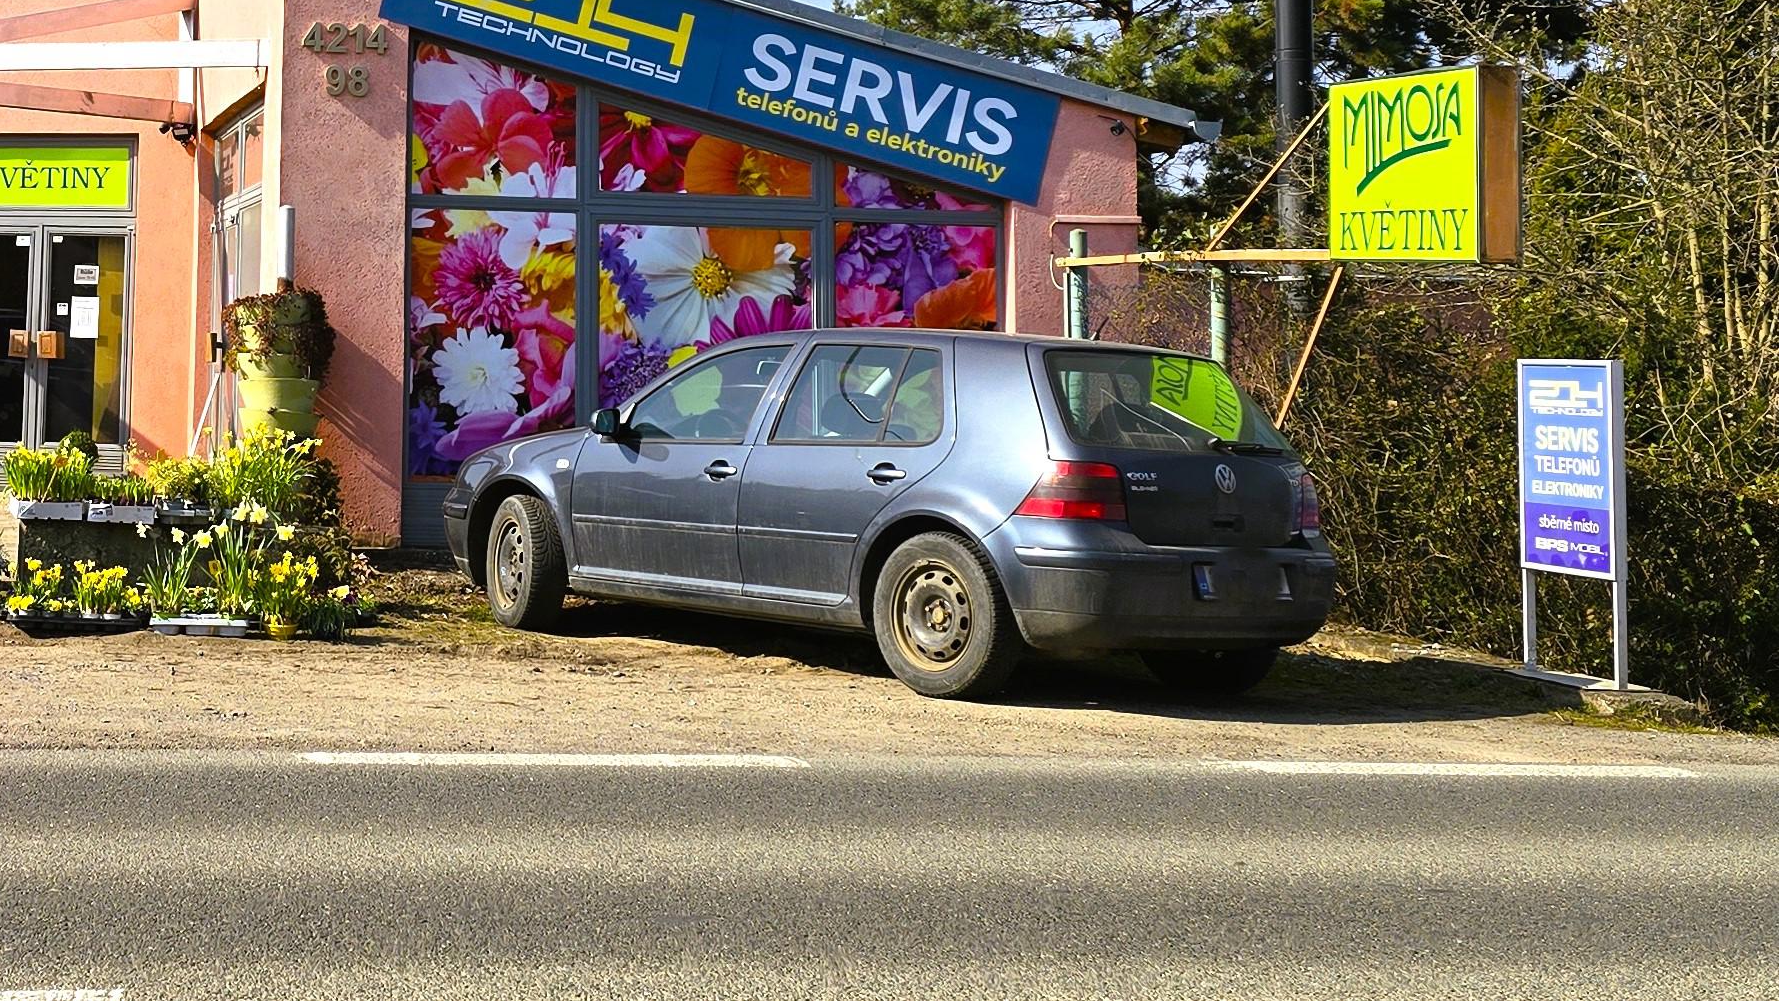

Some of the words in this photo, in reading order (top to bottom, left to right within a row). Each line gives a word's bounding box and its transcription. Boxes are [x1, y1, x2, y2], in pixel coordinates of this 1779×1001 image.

[302, 21, 389, 55] 4214
[434, 0, 681, 84] TECHNOLOGY
[324, 64, 369, 97] 98
[743, 33, 1018, 156] SERVIS
[736, 86, 839, 132] telefonů
[844, 121, 860, 138] a
[866, 126, 1007, 183] elektroniky
[1343, 80, 1462, 195] MIMOSA
[1339, 200, 1469, 251] KVĚTINY
[1530, 406, 1604, 417] TECHNOLOGY
[1534, 424, 1600, 454] SERVIS
[1127, 472, 1158, 481] GOLF
[1533, 454, 1601, 477] TELEFONŮ
[1531, 480, 1605, 500] ELEKTRONIKY
[1538, 513, 1573, 531] sběrné
[1573, 517, 1600, 534] místo
